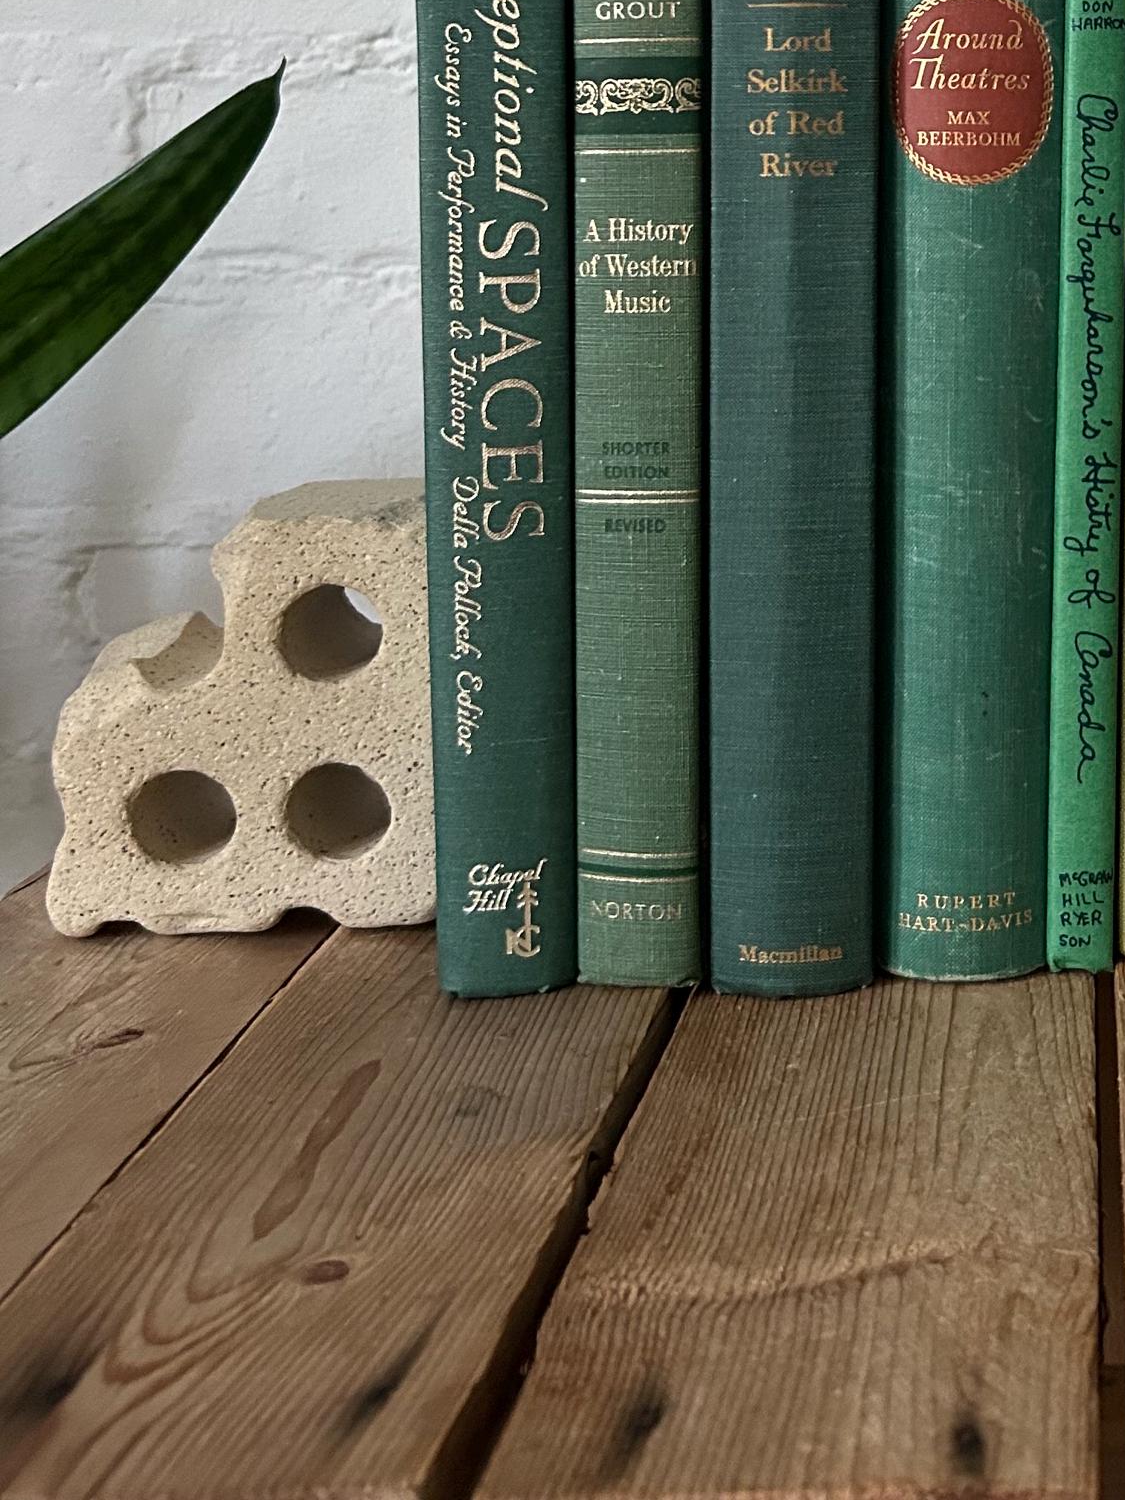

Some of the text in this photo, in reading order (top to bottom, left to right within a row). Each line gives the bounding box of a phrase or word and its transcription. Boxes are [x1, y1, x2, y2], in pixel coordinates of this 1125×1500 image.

[595, 1, 681, 20] GROUT
[1082, 0, 1113, 13] DON
[763, 27, 832, 52] Lord
[911, 18, 1024, 55] Around
[747, 68, 848, 93] Selkirk
[908, 53, 1031, 91] Theatres
[749, 110, 845, 135] of Red
[947, 110, 991, 125] MAX
[916, 130, 1021, 146] BEERBOHM
[1074, 94, 1119, 207] Charlie
[759, 152, 838, 177] River
[434, 22, 478, 450] Essays in Performance & History
[583, 217, 694, 245] A History
[579, 253, 700, 277] of Western
[604, 290, 672, 314] Music
[1066, 212, 1122, 440] Farquharson's
[478, 219, 545, 542] SPACES
[602, 441, 671, 456] SHORTER
[604, 465, 670, 479] EDITION
[604, 518, 667, 534] REVISED
[1067, 569, 1117, 609] of
[450, 476, 483, 755] Della Pollock, Editor
[1074, 630, 1113, 784] Canada
[467, 858, 548, 889] Chapel
[462, 888, 514, 916] Hill
[591, 900, 682, 920] NORTON
[916, 891, 1016, 909] RUPERT
[1062, 891, 1105, 908] HILL
[1060, 909, 1103, 927] RYER
[1059, 934, 1091, 948] SON
[738, 944, 843, 964] Macmillan
